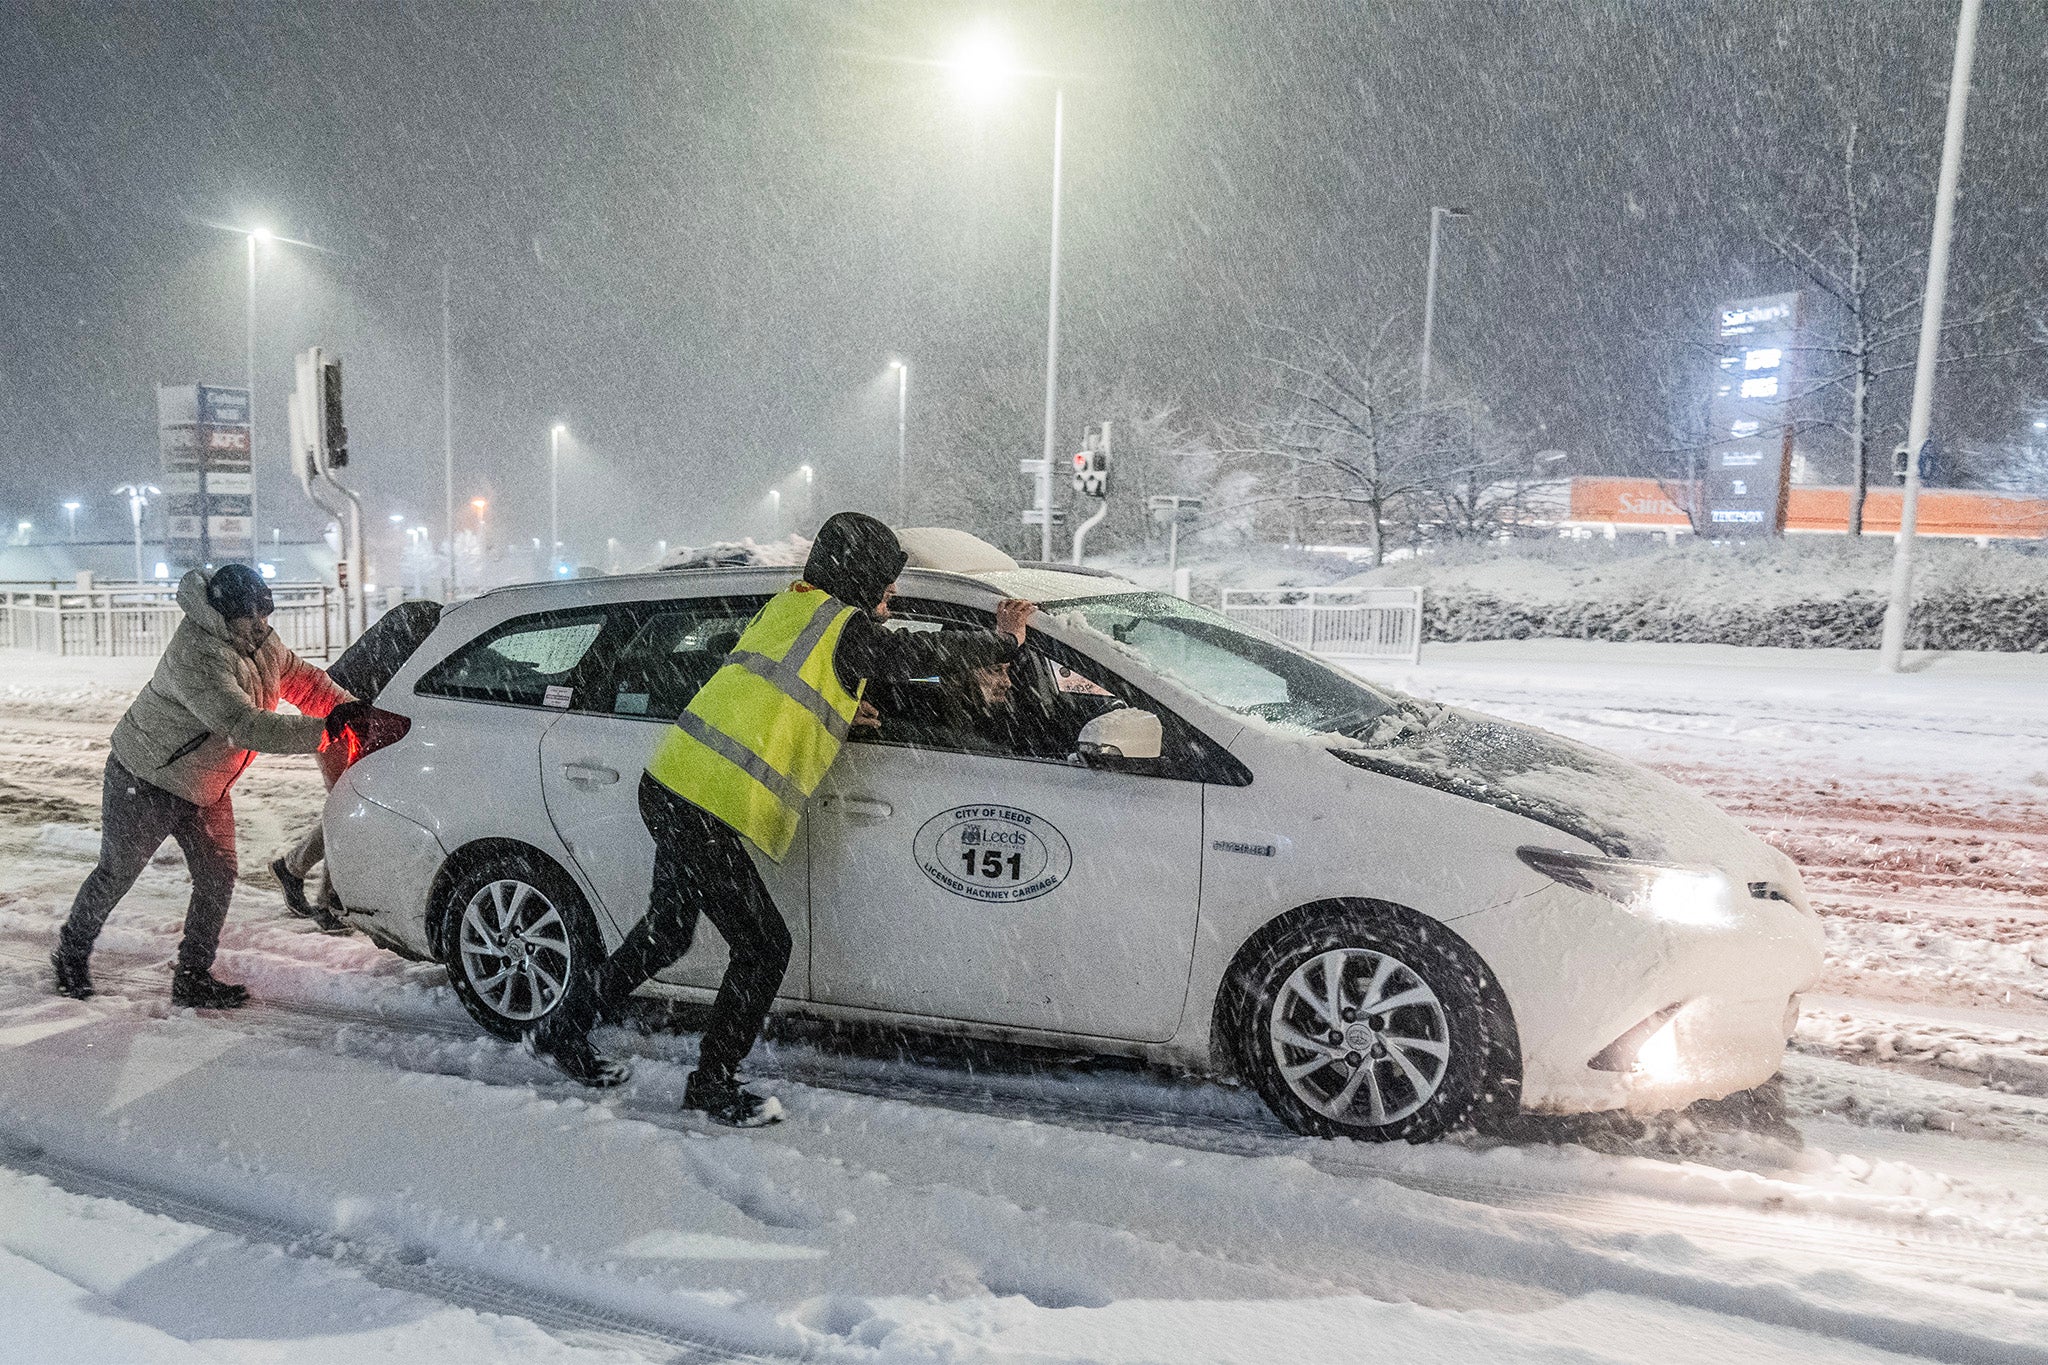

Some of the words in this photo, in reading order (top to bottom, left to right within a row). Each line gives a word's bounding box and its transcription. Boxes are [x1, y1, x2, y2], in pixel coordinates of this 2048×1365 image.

[955, 809, 979, 819] CITY
[982, 808, 996, 817] OF
[999, 809, 1032, 825] LEEDS
[982, 829, 1027, 845] Leeds
[961, 848, 1021, 880] 151
[924, 863, 964, 891] LICENSED
[966, 886, 1010, 899] HACKNEY
[1012, 875, 1058, 898] CARRIAGE
